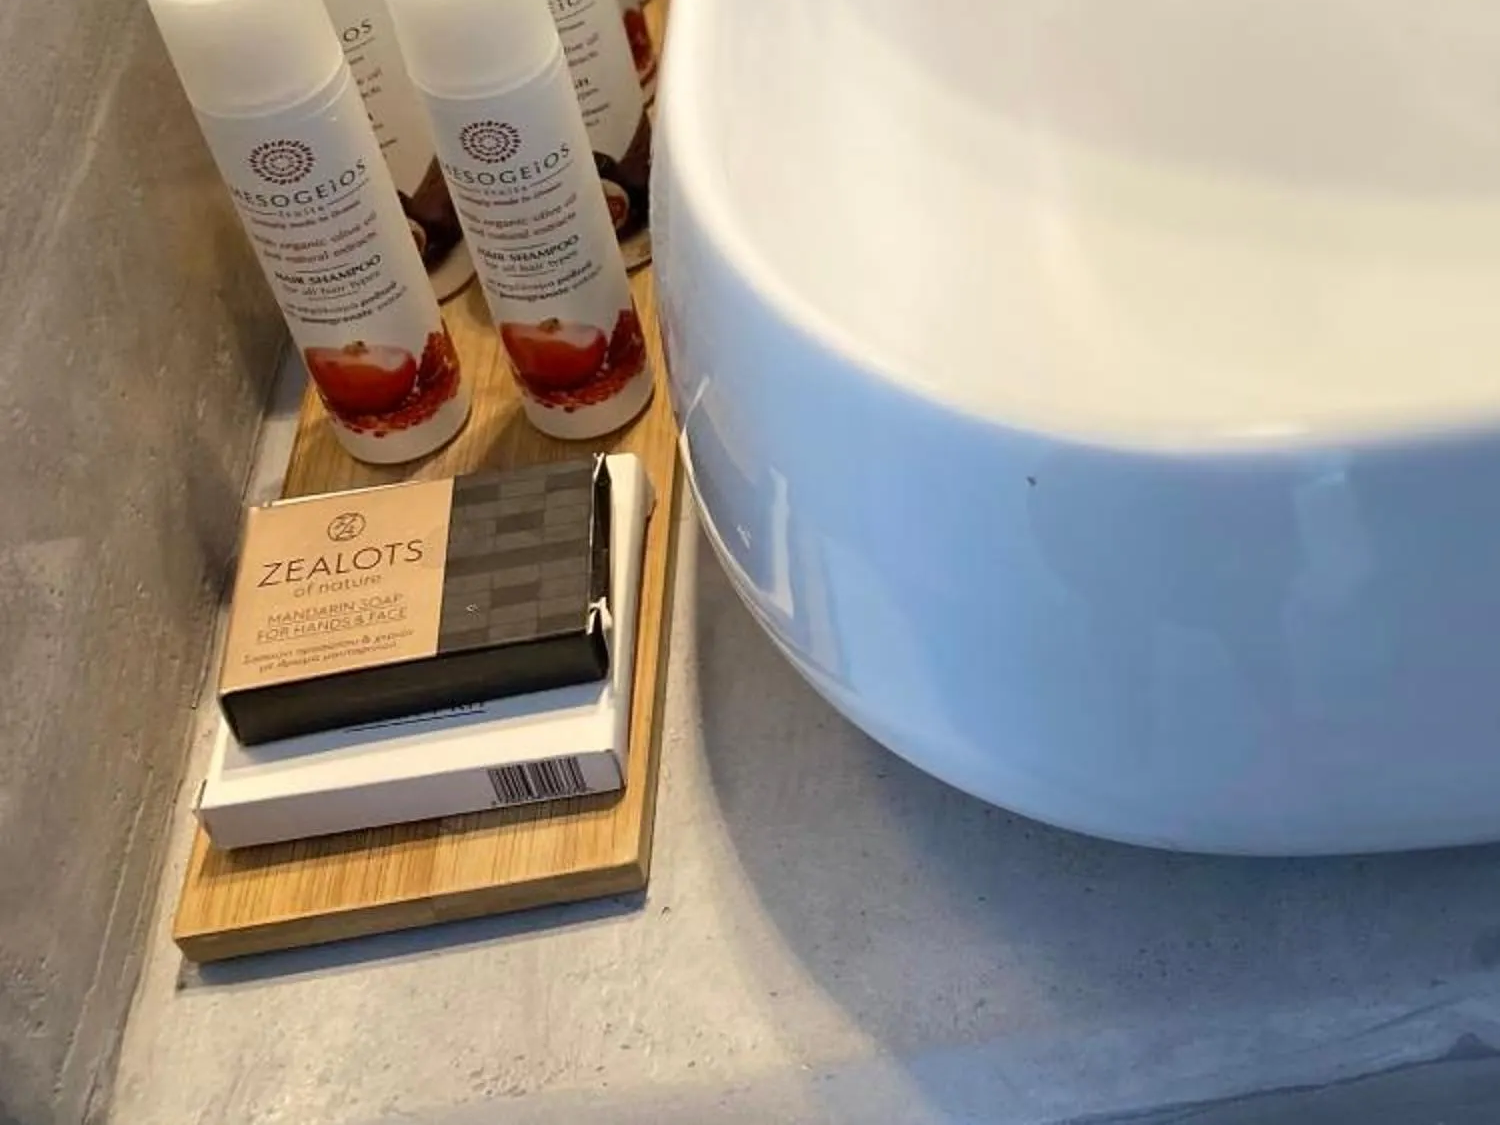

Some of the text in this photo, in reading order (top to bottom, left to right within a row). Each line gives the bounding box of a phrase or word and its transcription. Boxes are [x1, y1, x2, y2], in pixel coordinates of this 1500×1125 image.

[508, 234, 580, 262] SHAMPOO
[307, 254, 382, 285] SHAMPOO
[257, 539, 424, 588] ZEALOTS
[293, 574, 382, 598] of nature
[257, 623, 291, 644] FOR
[293, 616, 351, 637] HANDS
